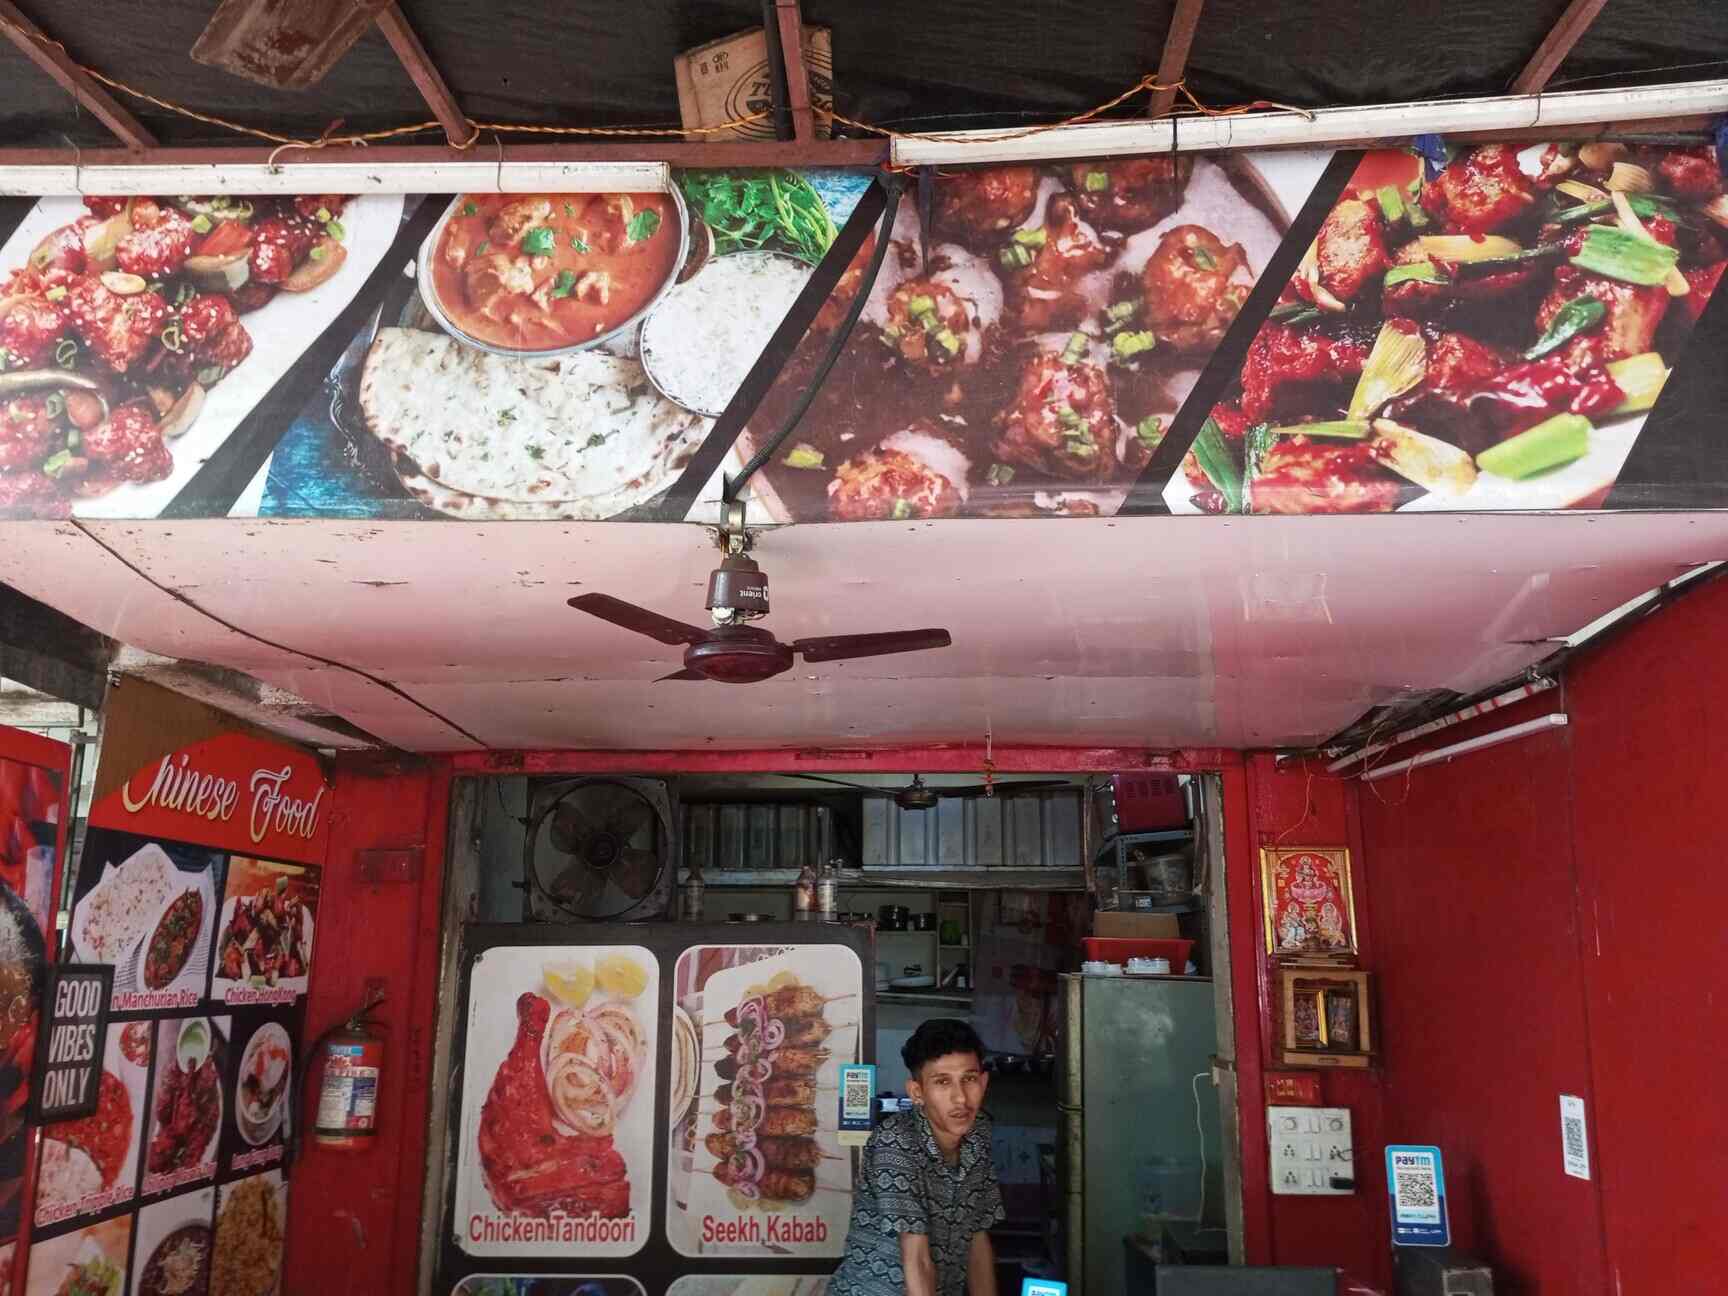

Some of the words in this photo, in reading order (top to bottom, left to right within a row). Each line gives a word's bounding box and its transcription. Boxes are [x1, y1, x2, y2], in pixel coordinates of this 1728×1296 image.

[250, 765, 324, 843] Food
[54, 980, 101, 1018] GOOD
[48, 1024, 96, 1064] VIBES
[42, 1067, 91, 1109] ONLY
[469, 1214, 546, 1242] Chicken
[551, 1214, 636, 1242] Tandoori
[703, 1214, 760, 1242] Seekh
[766, 1215, 827, 1242] Kabab
